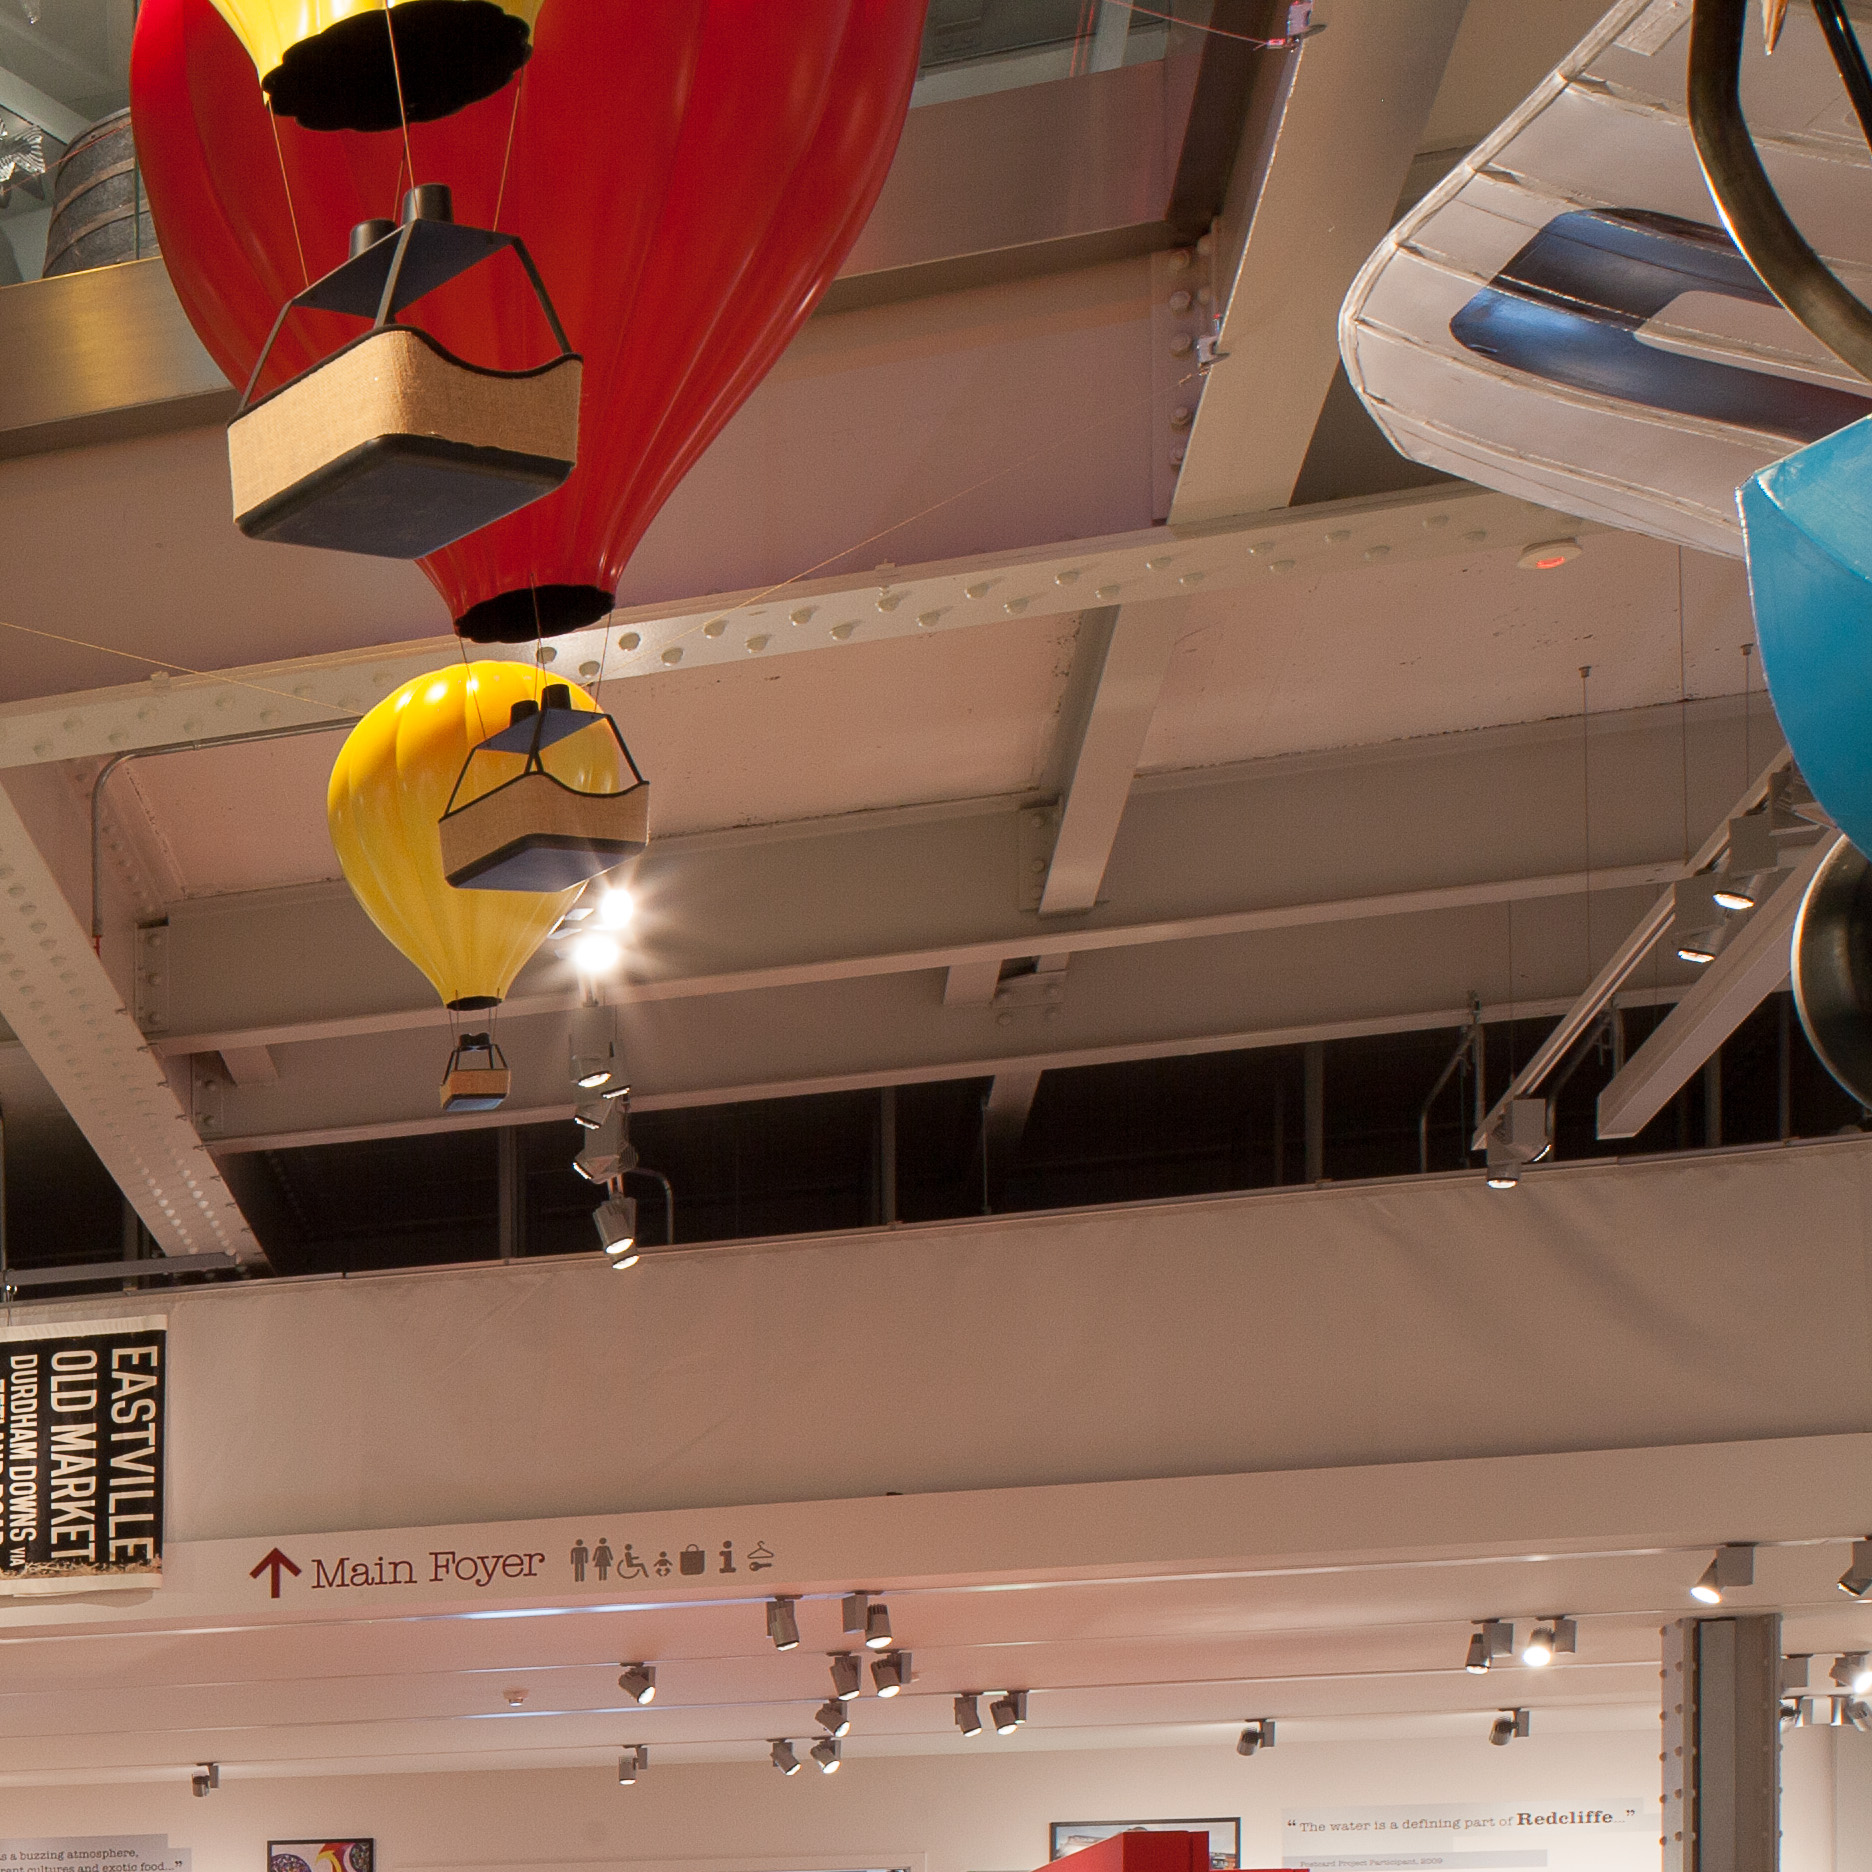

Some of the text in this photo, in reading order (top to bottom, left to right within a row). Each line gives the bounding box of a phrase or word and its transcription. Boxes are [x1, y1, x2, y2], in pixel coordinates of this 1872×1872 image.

[9, 1354, 38, 1567] DURDHAM DOWNS VIA
[50, 1350, 96, 1562] OLD MARKET
[108, 1345, 157, 1560] EASTVILLE
[311, 1550, 545, 1589] Main Foyer
[20, 1850, 64, 1862] buzzing
[67, 1848, 139, 1861] atmosphere,
[1330, 1820, 1371, 1832] water
[1375, 1819, 1386, 1831] is
[1391, 1822, 1398, 1830] a
[1402, 1816, 1461, 1831] defining
[1465, 1816, 1495, 1829] part
[1499, 1815, 1513, 1827] of
